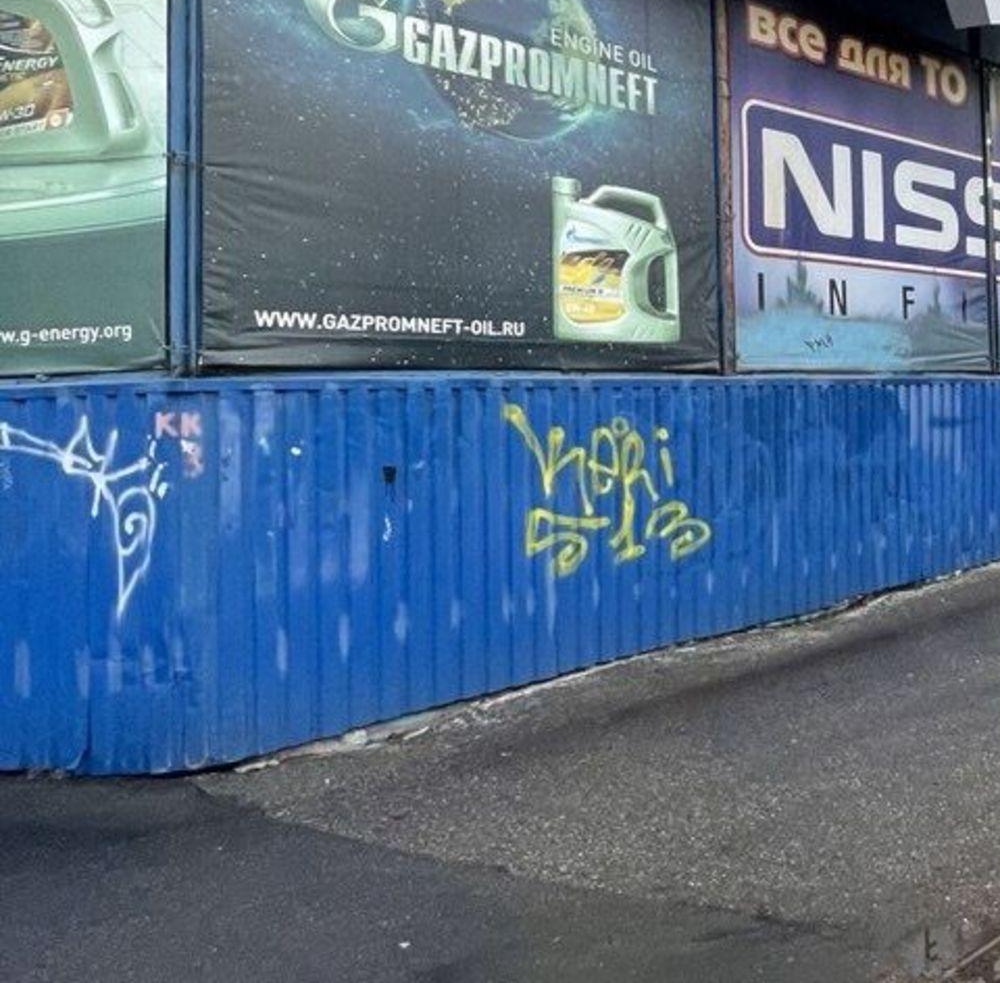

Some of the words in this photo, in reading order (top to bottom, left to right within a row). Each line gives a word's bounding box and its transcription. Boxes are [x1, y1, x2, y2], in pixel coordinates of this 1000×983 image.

[401, 15, 659, 116] GAZPROMNEFT
[550, 26, 624, 63] ENGINE
[628, 48, 658, 74] OIL
[920, 53, 967, 108] ТО
[0, 325, 132, 346] w.g-energy.org
[253, 309, 526, 337] WWW.GAZPROMNEFT-OIL.RU
